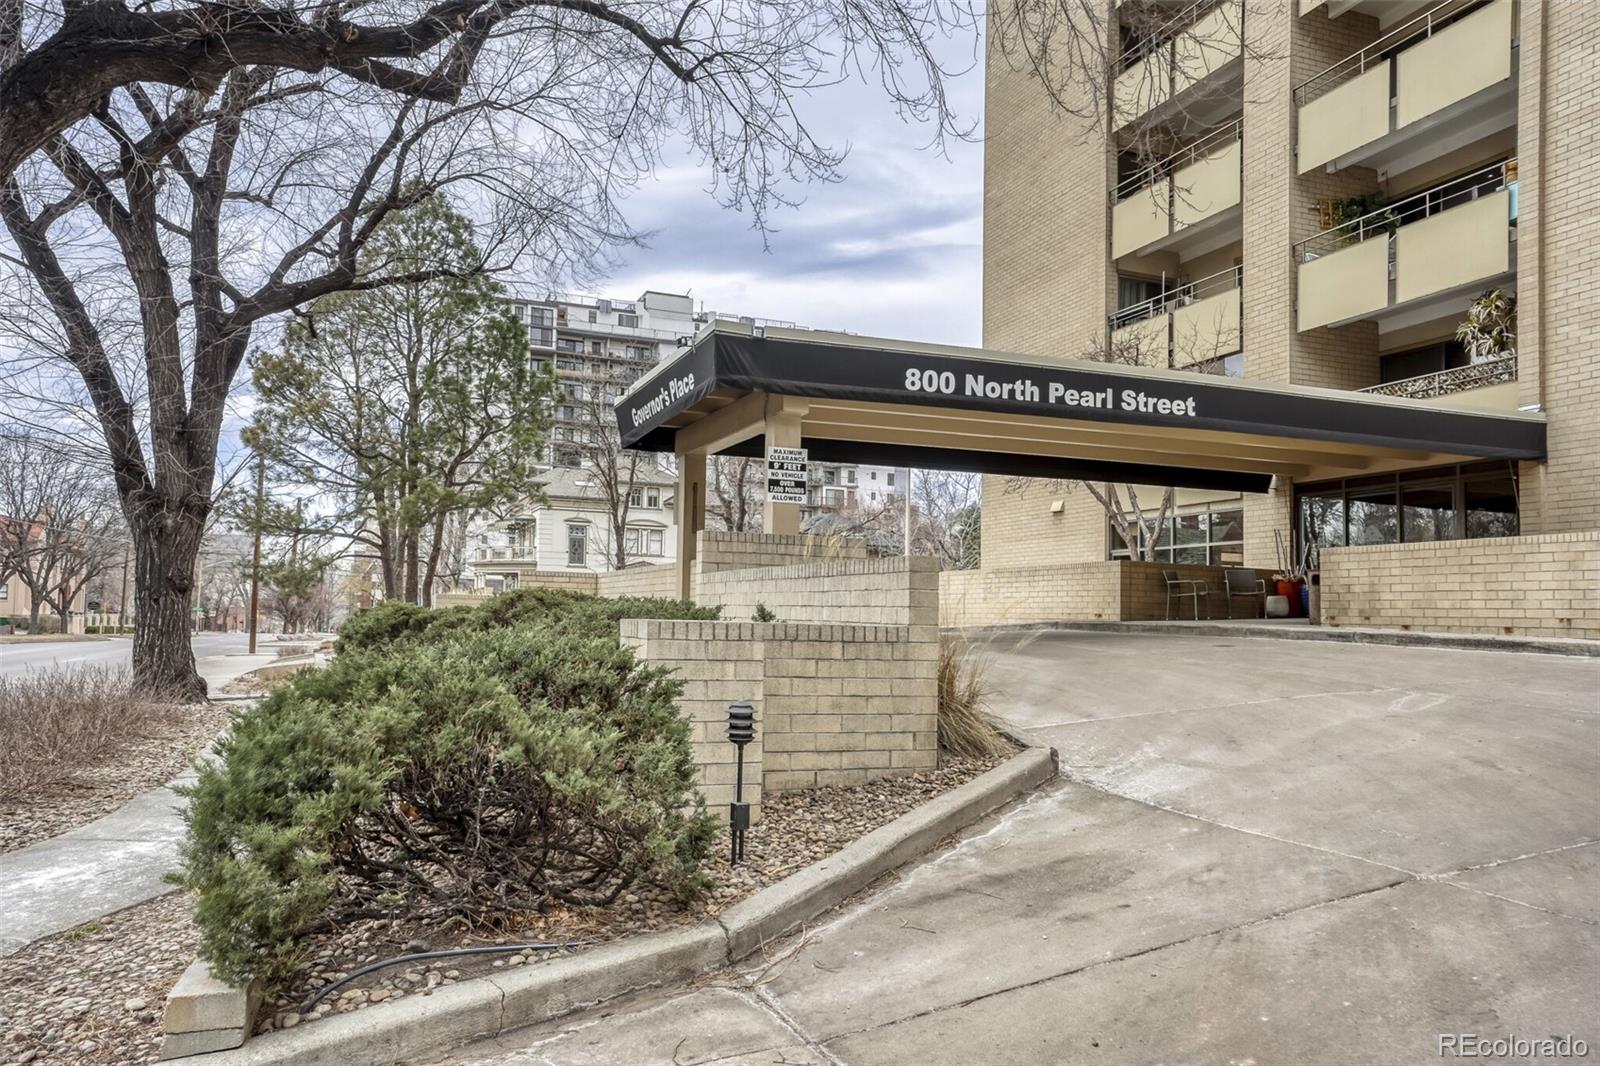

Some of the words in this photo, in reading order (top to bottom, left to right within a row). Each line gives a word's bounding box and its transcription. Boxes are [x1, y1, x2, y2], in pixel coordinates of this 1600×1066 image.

[631, 387, 670, 427] Governor's
[669, 373, 695, 402] Place
[904, 368, 956, 394] 800
[964, 374, 1040, 402] North
[1048, 382, 1113, 409] Pearl
[1120, 390, 1196, 417] Street
[771, 494, 803, 502] ALLOWED
[785, 486, 805, 494] POUNDS
